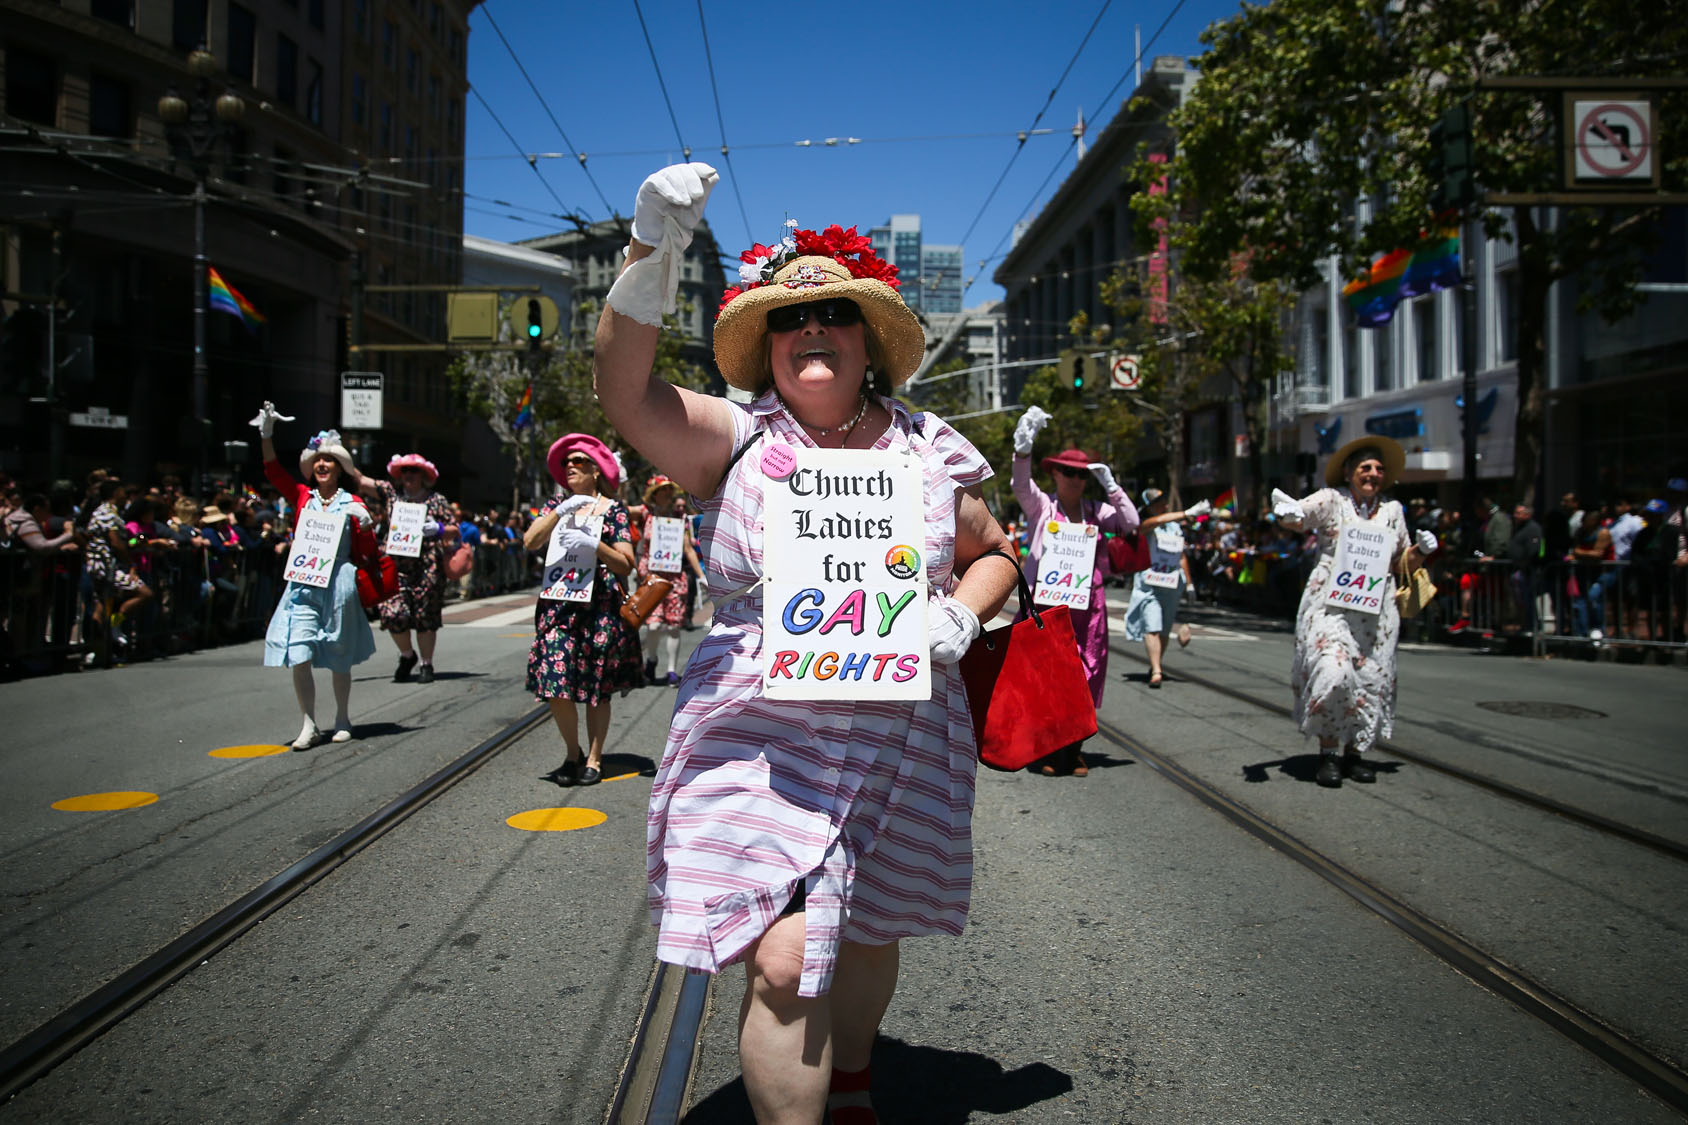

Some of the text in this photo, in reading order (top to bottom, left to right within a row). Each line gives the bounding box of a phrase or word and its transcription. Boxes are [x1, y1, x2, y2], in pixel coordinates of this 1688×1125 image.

[770, 446, 793, 462] Straight
[763, 457, 785, 473] Narrow
[788, 468, 894, 501] Church
[305, 518, 336, 532] Church
[791, 509, 893, 540] Ladies
[304, 530, 332, 544] Ladies
[392, 532, 420, 544] GAY
[1347, 528, 1384, 544] Church
[308, 544, 321, 555] for
[389, 544, 418, 553] RIGHTS
[564, 551, 578, 562] for
[654, 550, 681, 561] GAY
[1053, 543, 1086, 558] Ladies
[1346, 542, 1380, 558] Ladies
[293, 554, 332, 571] GAY
[822, 553, 866, 582] for
[1059, 560, 1074, 570] for
[1353, 560, 1368, 571] for
[286, 570, 328, 585] RIGHTS
[549, 567, 592, 584] GAY
[1045, 570, 1090, 589] GAY
[1336, 571, 1383, 592] GAY
[543, 586, 589, 599] RIGHTS
[1038, 589, 1087, 605] RIGHTS
[1329, 589, 1380, 608] RIGHTS
[781, 588, 917, 638] GAY
[769, 650, 919, 682] RIGHTS
